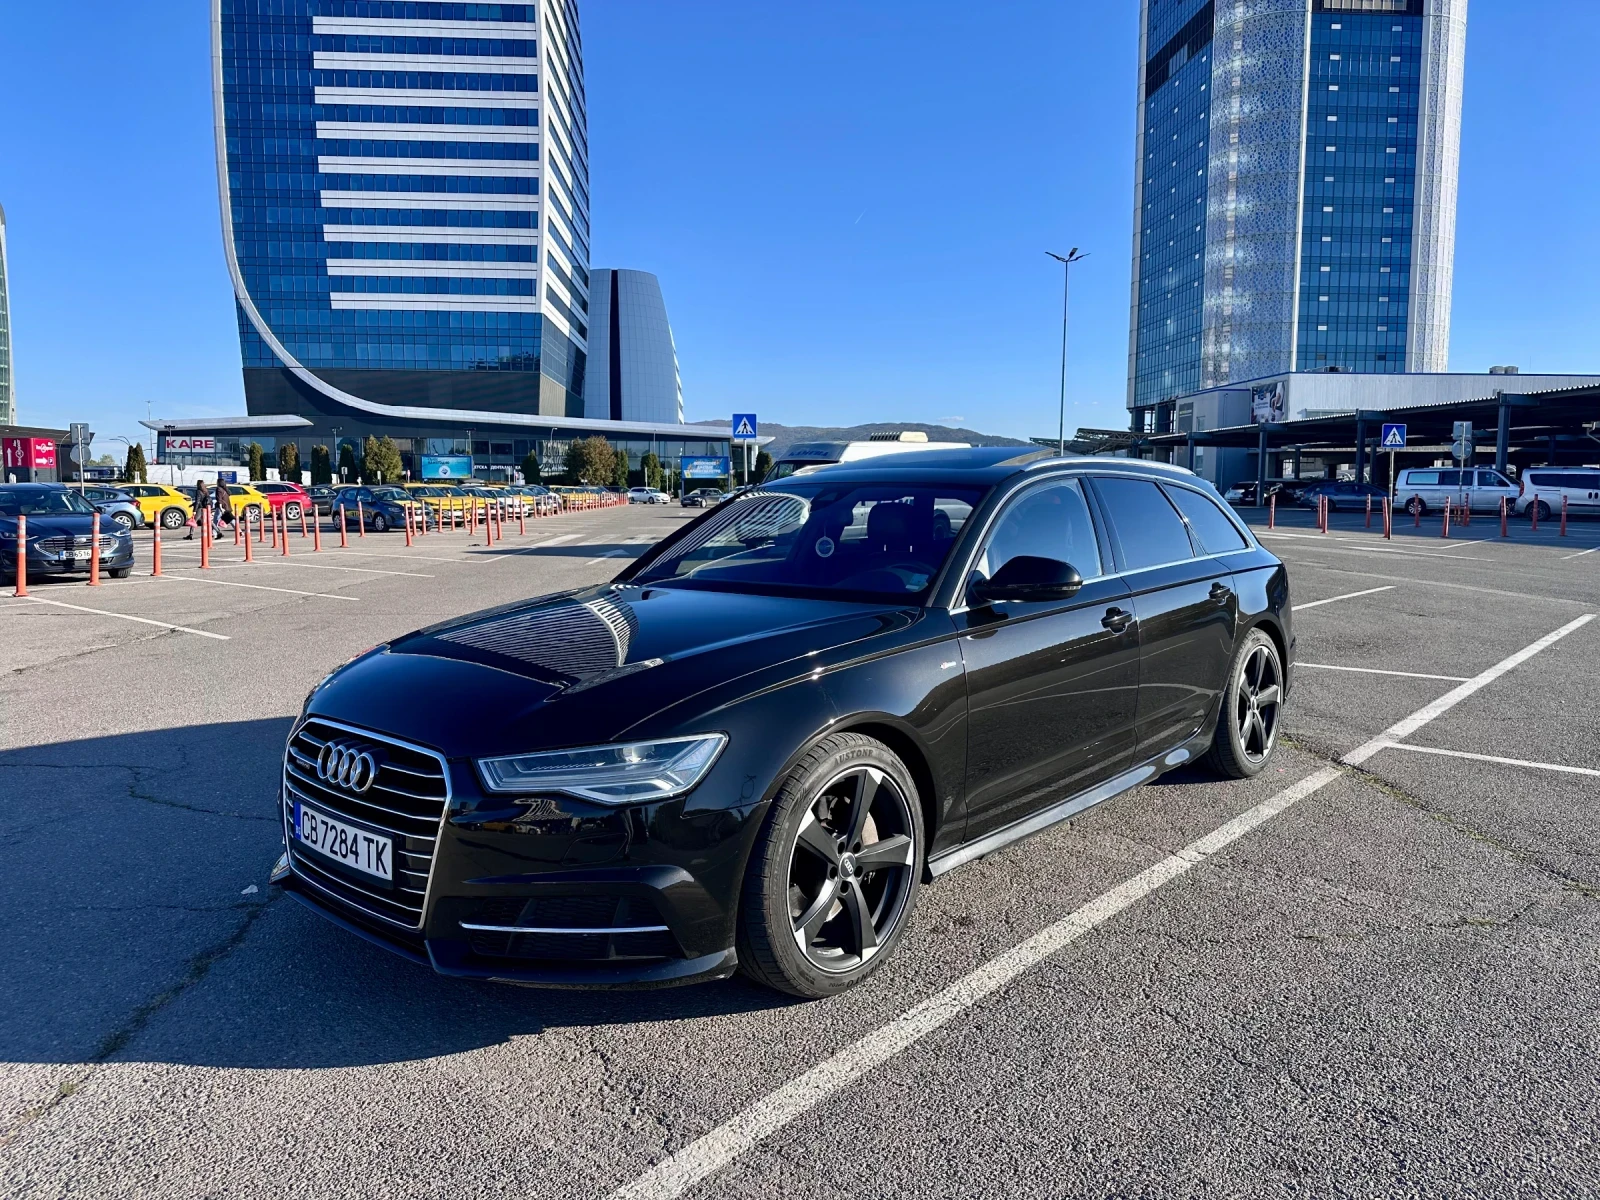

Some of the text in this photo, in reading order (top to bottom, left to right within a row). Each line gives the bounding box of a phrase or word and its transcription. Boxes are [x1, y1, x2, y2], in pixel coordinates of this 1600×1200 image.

[166, 439, 214, 449] KARE
[302, 811, 318, 845] CB
[321, 819, 360, 865] 7284
[363, 835, 388, 875] TK
